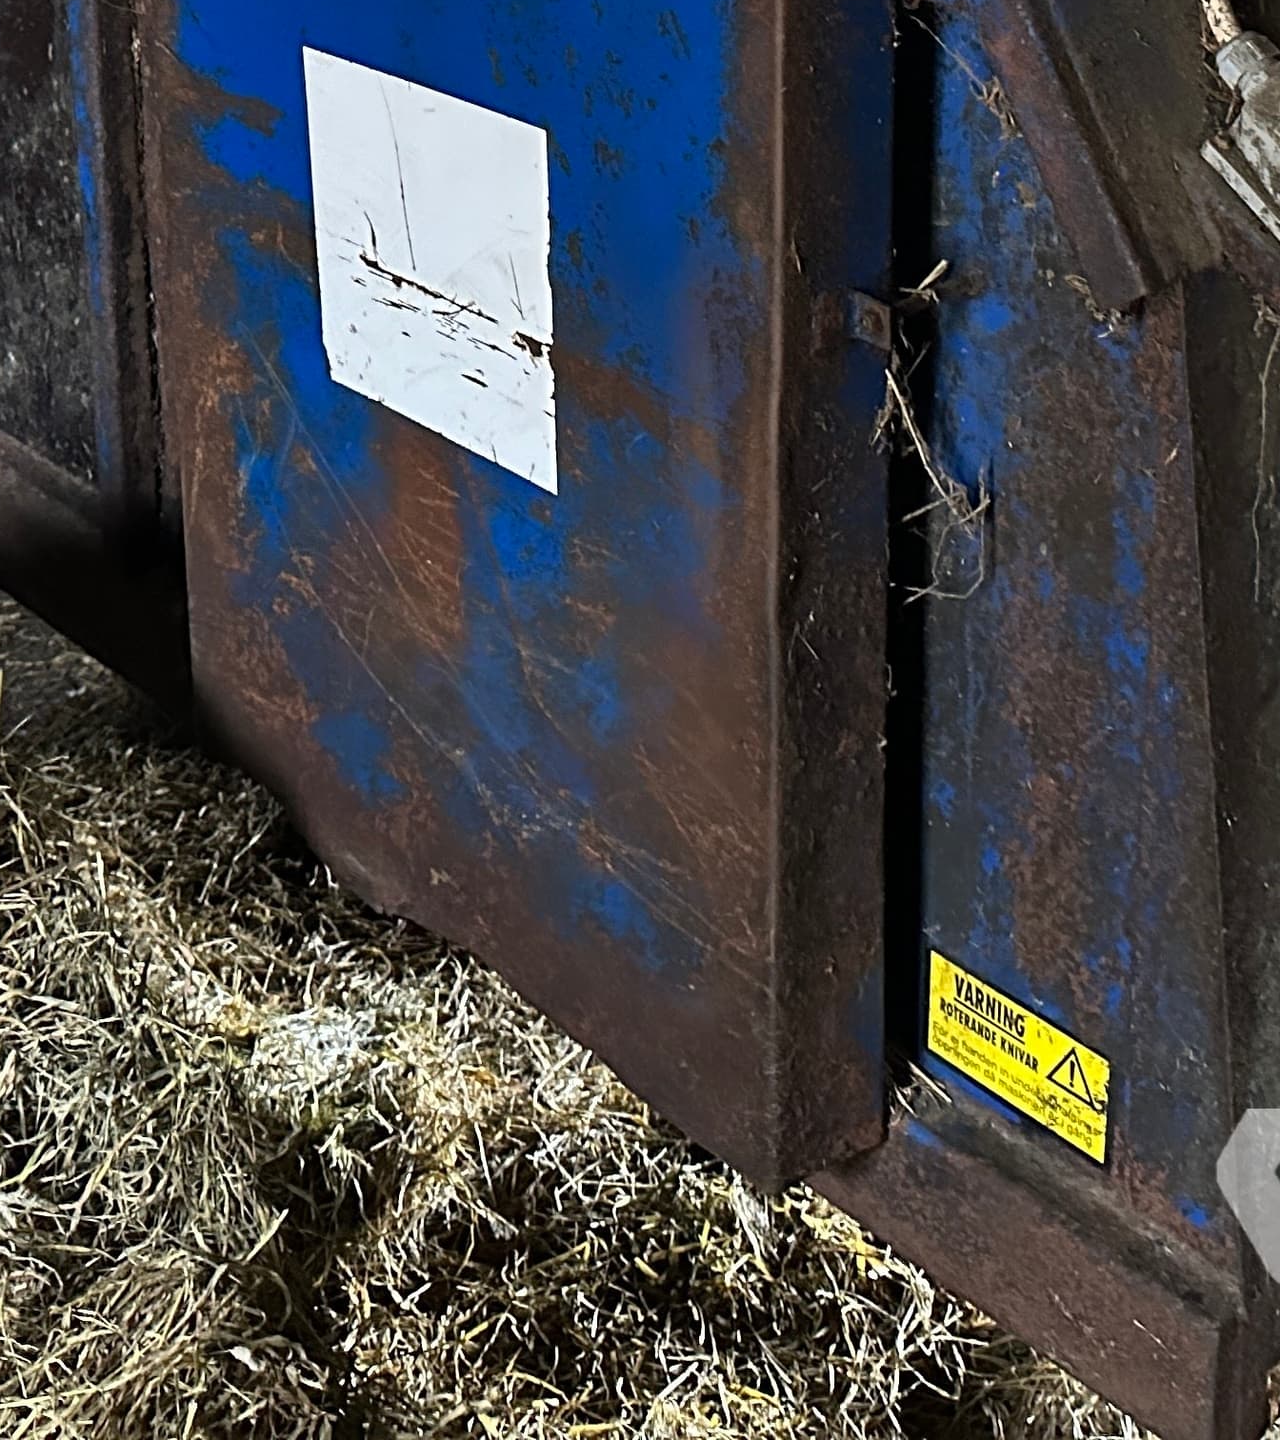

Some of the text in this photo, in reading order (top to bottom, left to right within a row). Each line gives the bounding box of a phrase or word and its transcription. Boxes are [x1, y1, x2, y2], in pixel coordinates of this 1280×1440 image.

[939, 996, 1039, 1073] ROTERANDE KNIVAR
[954, 973, 1025, 1038] VARNING
